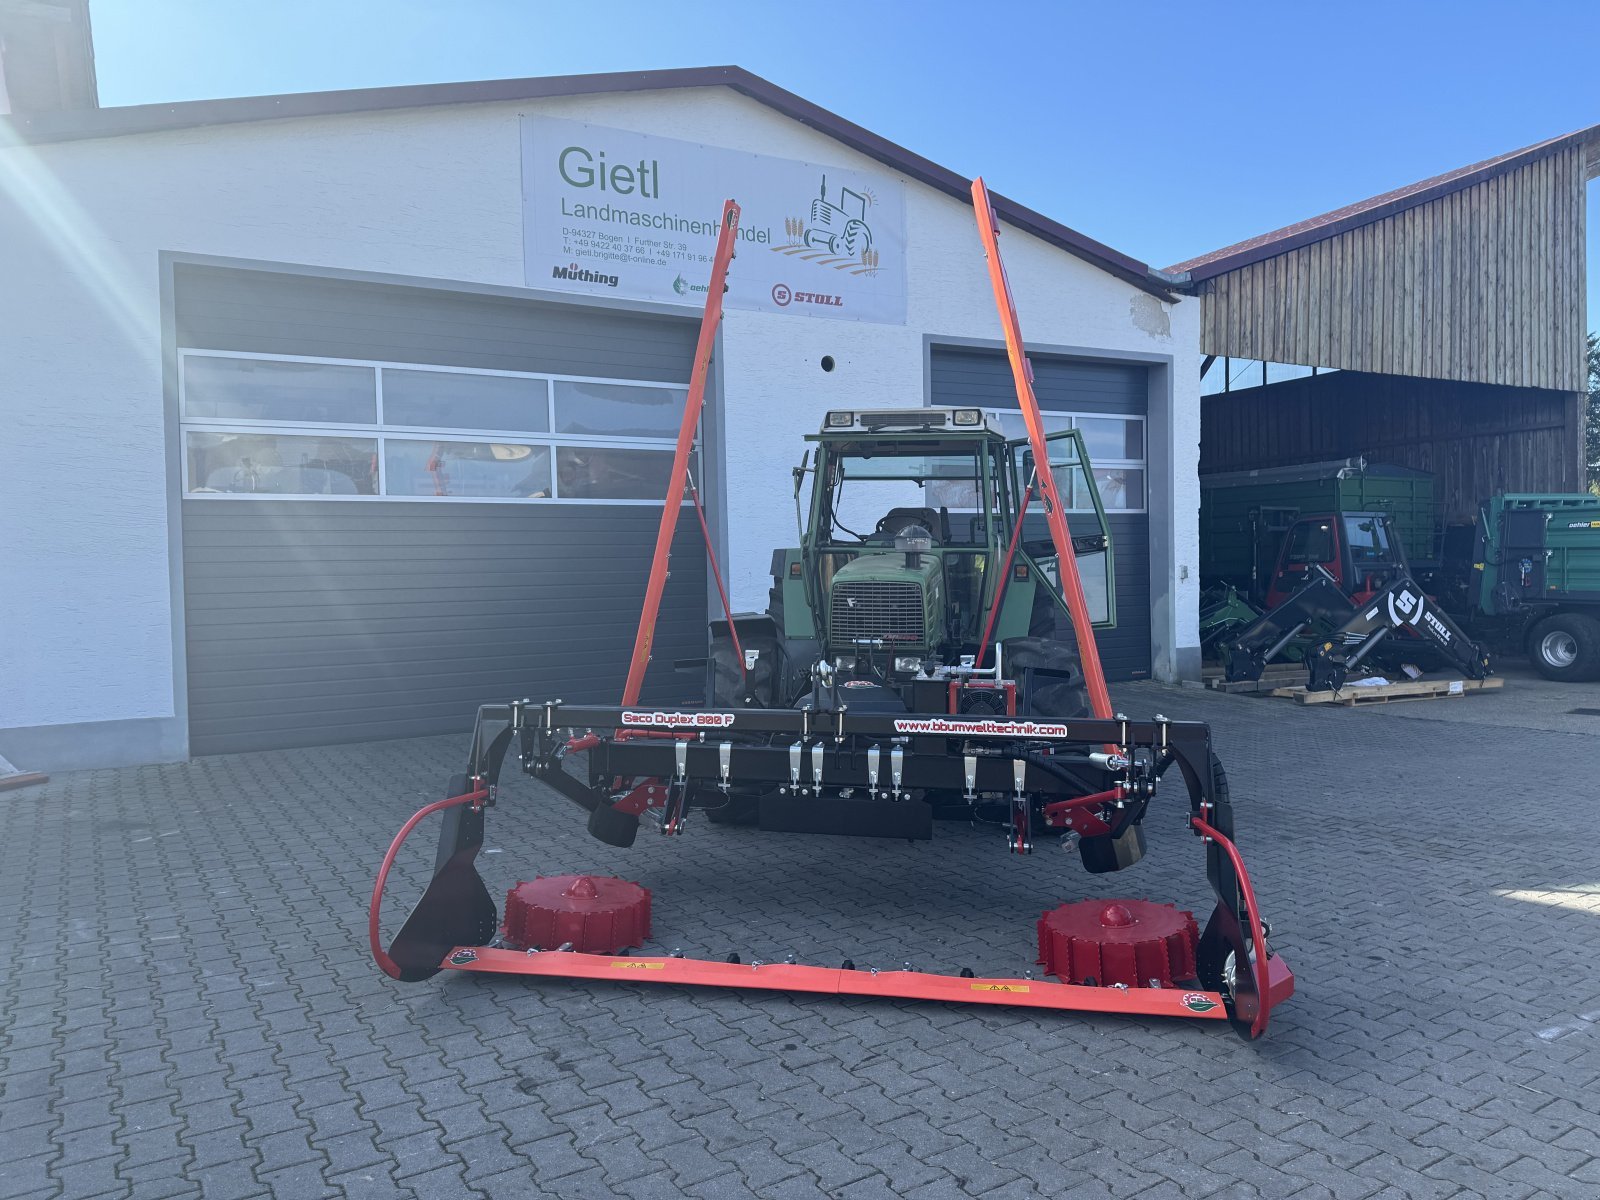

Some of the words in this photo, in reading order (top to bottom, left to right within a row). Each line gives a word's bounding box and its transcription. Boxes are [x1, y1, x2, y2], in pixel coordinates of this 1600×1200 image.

[559, 146, 658, 199] Gietl
[561, 197, 771, 244] Landmaschinenhndel
[562, 227, 596, 239] D-94327
[598, 232, 623, 242] Bogen
[663, 241, 676, 250] Str.
[677, 243, 687, 251] 39
[563, 236, 571, 245] T:
[574, 239, 589, 247] +49
[590, 241, 610, 250] 9422
[612, 243, 622, 251] 40
[624, 245, 633, 253] 37
[656, 249, 671, 258] +49
[673, 251, 686, 260] 171
[687, 253, 696, 261] 91
[698, 254, 708, 263] 96
[563, 246, 574, 255] M:
[575, 248, 667, 266] gietl.brigitte@t-online.de
[552, 262, 619, 287] Müthing
[794, 291, 843, 306] STOLL
[1424, 611, 1452, 642] STOLL
[623, 713, 653, 724] Seco
[655, 714, 694, 726] Duplex
[696, 716, 722, 725] 800
[724, 716, 733, 725] F
[897, 720, 1066, 736] www.bbumwelttechnik.com
